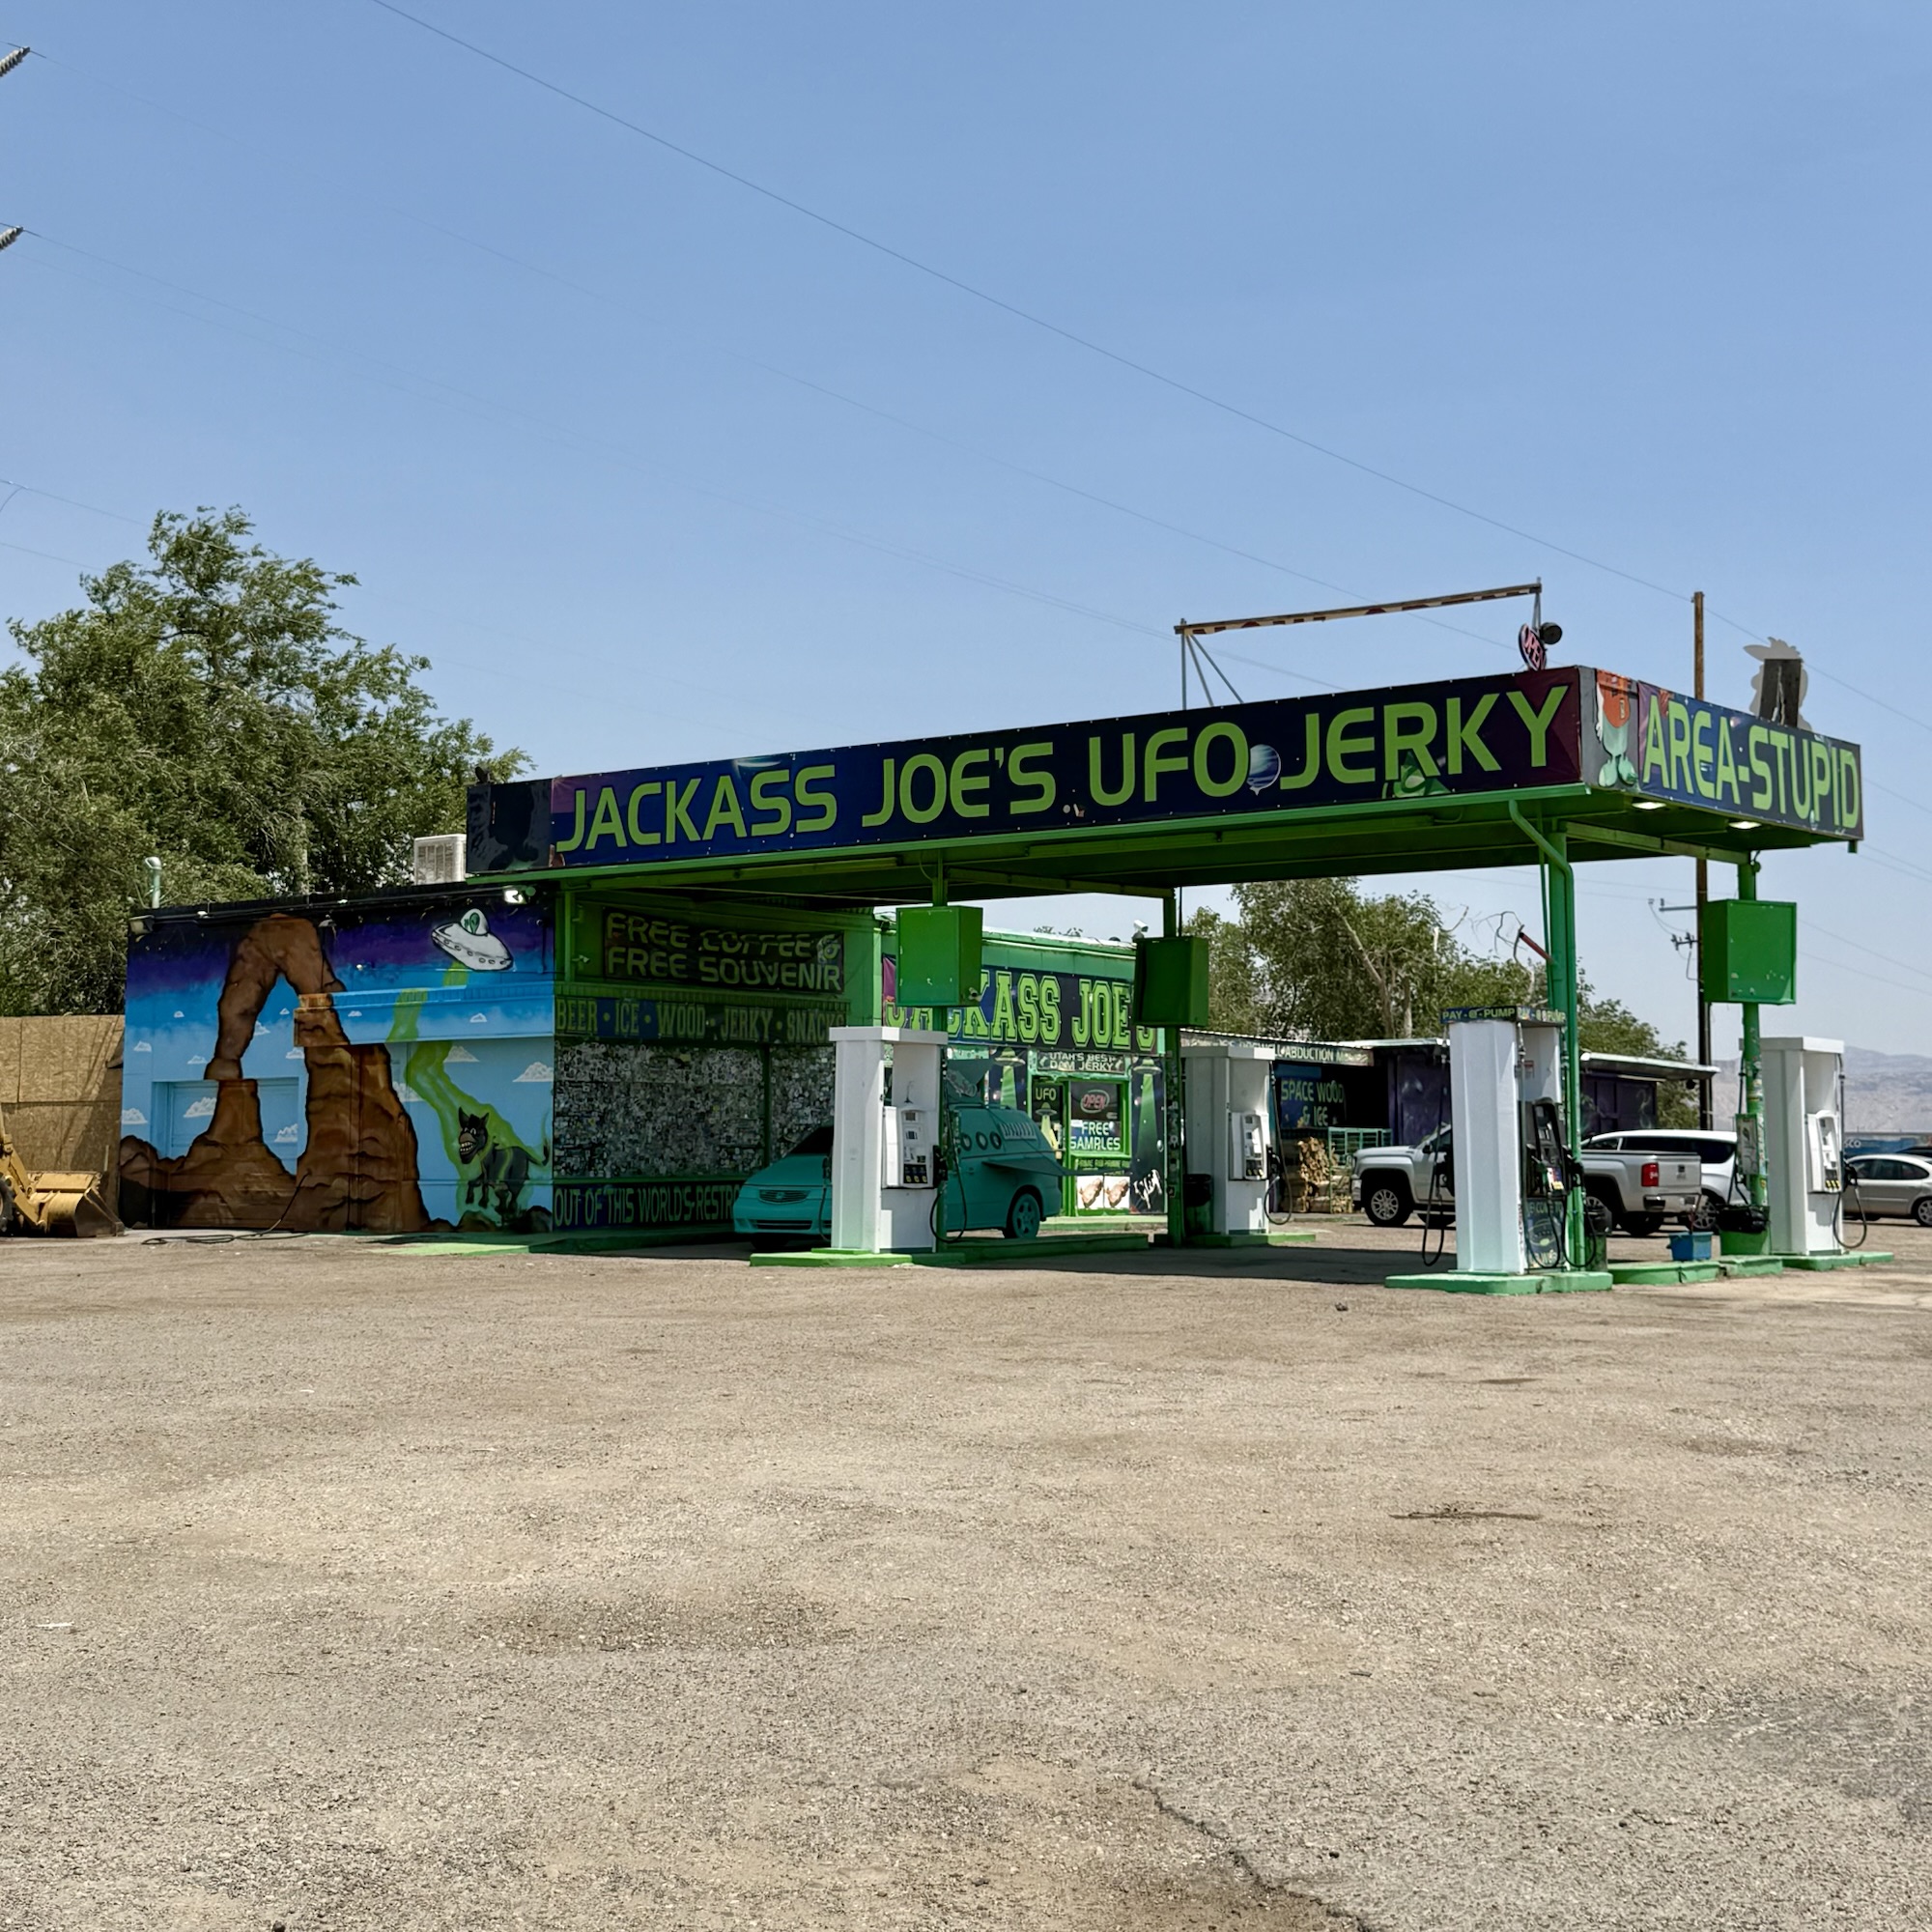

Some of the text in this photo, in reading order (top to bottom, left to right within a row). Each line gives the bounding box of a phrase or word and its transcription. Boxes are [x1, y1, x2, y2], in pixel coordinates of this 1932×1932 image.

[556, 685, 1570, 852] JACKASS JOE'S UFO JERKY
[1643, 695, 1859, 829] AREA-STUPID
[608, 913, 690, 949] FREE
[700, 929, 811, 957] COFFEE
[609, 946, 841, 991] FREE SOUVENIR
[556, 997, 598, 1033] BEER
[615, 1000, 640, 1036] ICE
[658, 1003, 707, 1039] WOOD
[721, 1007, 774, 1043] JERKY
[1442, 1011, 1463, 1020] PAY
[1484, 1008, 1516, 1017] PUMP
[1049, 1051, 1084, 1061] UTAH'S
[1285, 1047, 1333, 1062] ABDUCTION
[1079, 1063, 1114, 1071] JERKY
[1035, 1088, 1057, 1100] UFO
[1281, 1080, 1345, 1102] SPACE WOOD
[1082, 1094, 1106, 1108] OPEN
[1314, 1106, 1328, 1126] ICE
[1081, 1121, 1109, 1135] FREE
[1070, 1136, 1121, 1150] SAMPLES
[554, 1189, 580, 1226] OUT
[585, 1188, 602, 1225] OF
[606, 1187, 634, 1223] THIS
